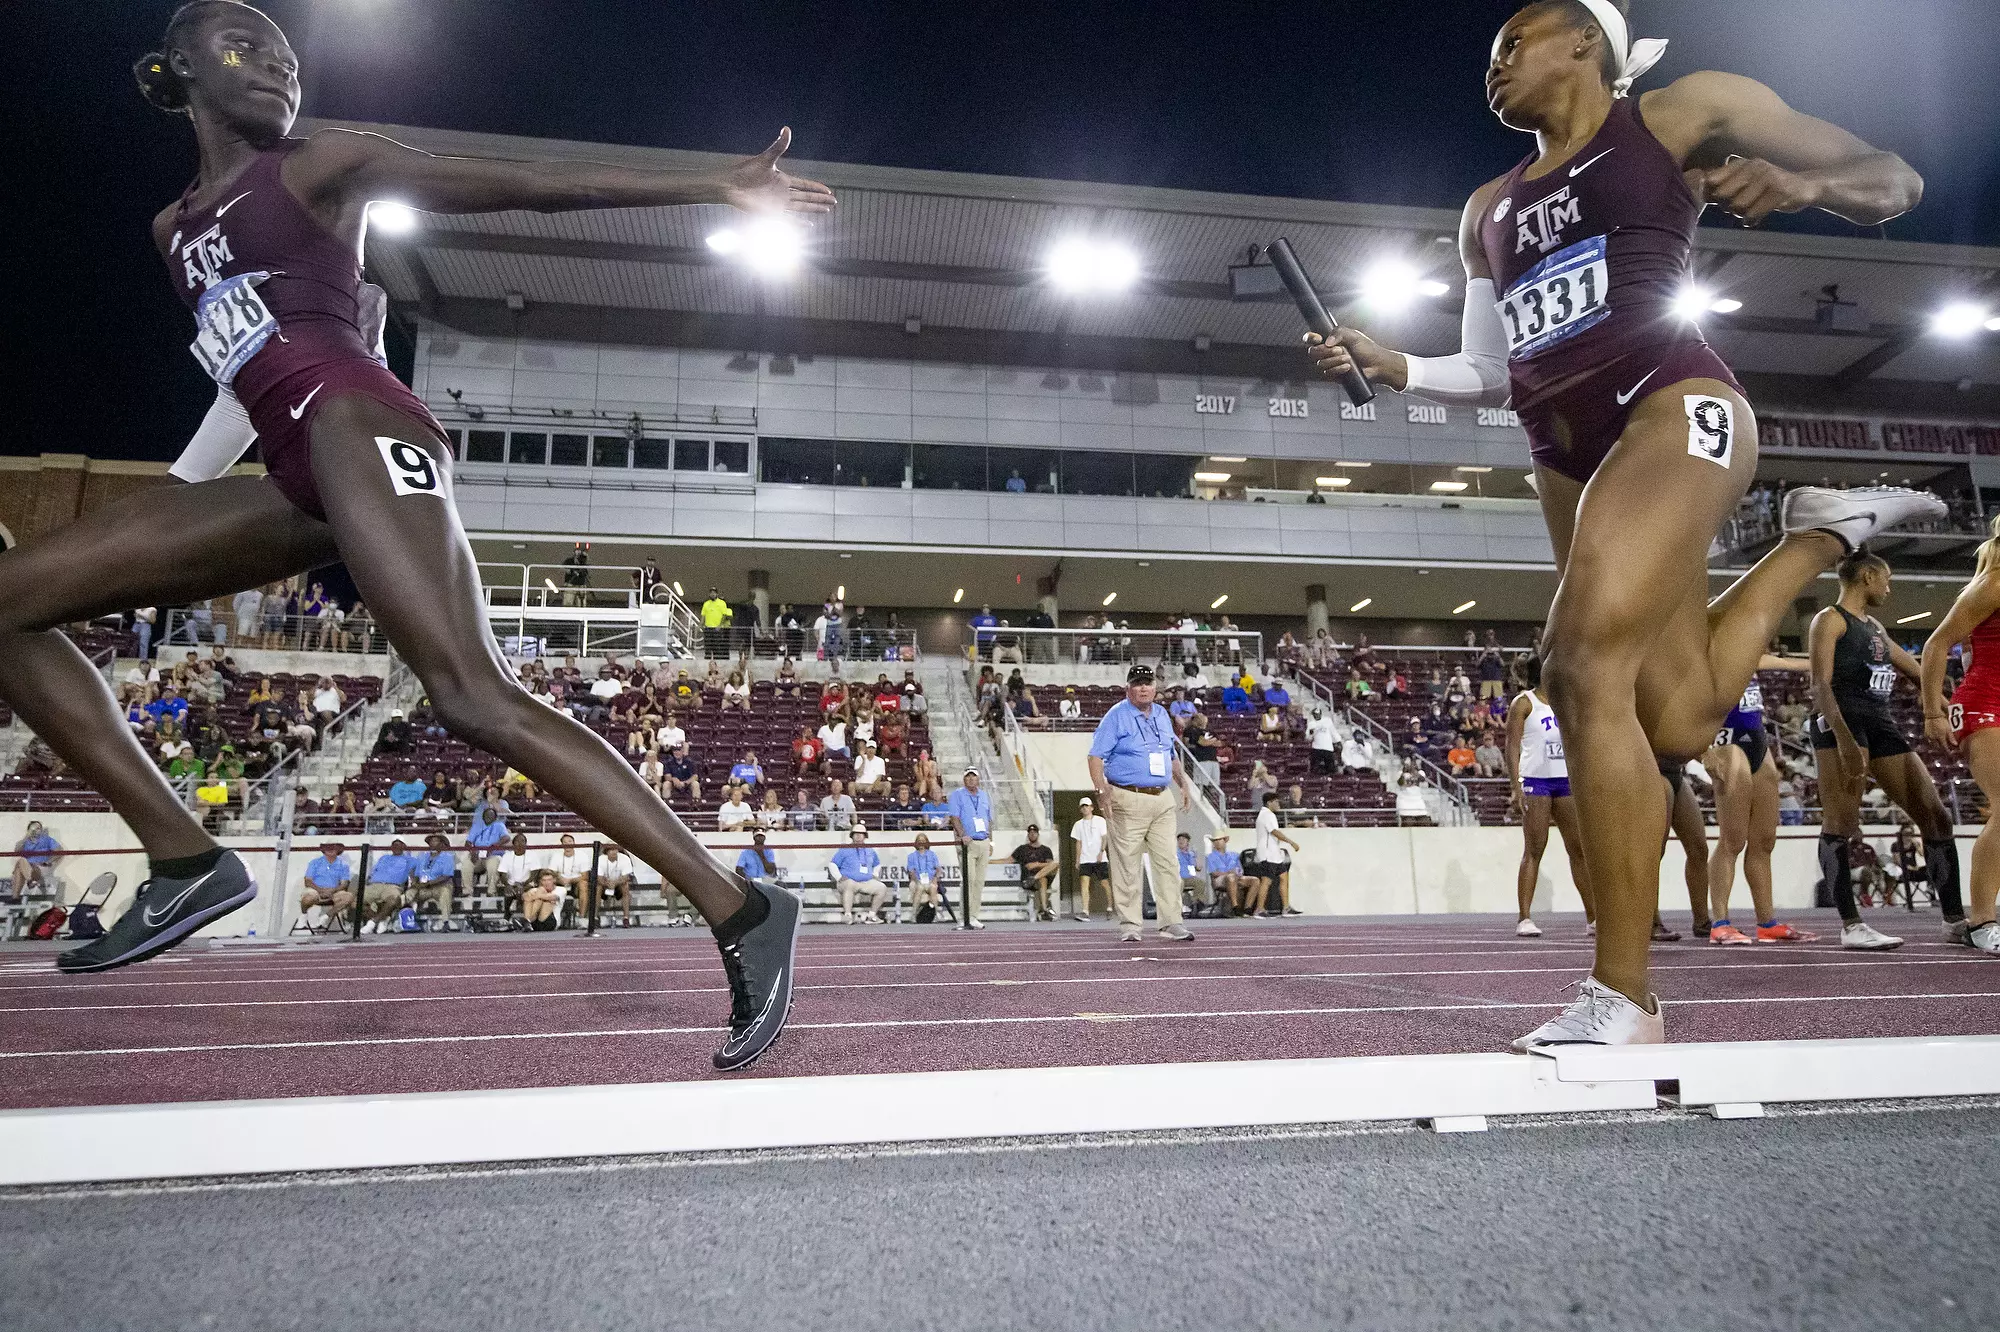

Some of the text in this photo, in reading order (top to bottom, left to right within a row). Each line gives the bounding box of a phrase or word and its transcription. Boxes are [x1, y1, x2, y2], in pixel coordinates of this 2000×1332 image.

[1504, 267, 1599, 344] 1331
[194, 285, 264, 377] 1328
[1195, 394, 1236, 414] 2017
[1268, 398, 1308, 418] 2013
[1340, 401, 1376, 420] 2011
[1407, 405, 1447, 424] 2010
[1477, 408, 1519, 427] 2009
[1694, 400, 1729, 459] 9
[1757, 418, 1880, 450] ATIONAL
[390, 442, 437, 491] 9
[1716, 729, 1729, 746] 3
